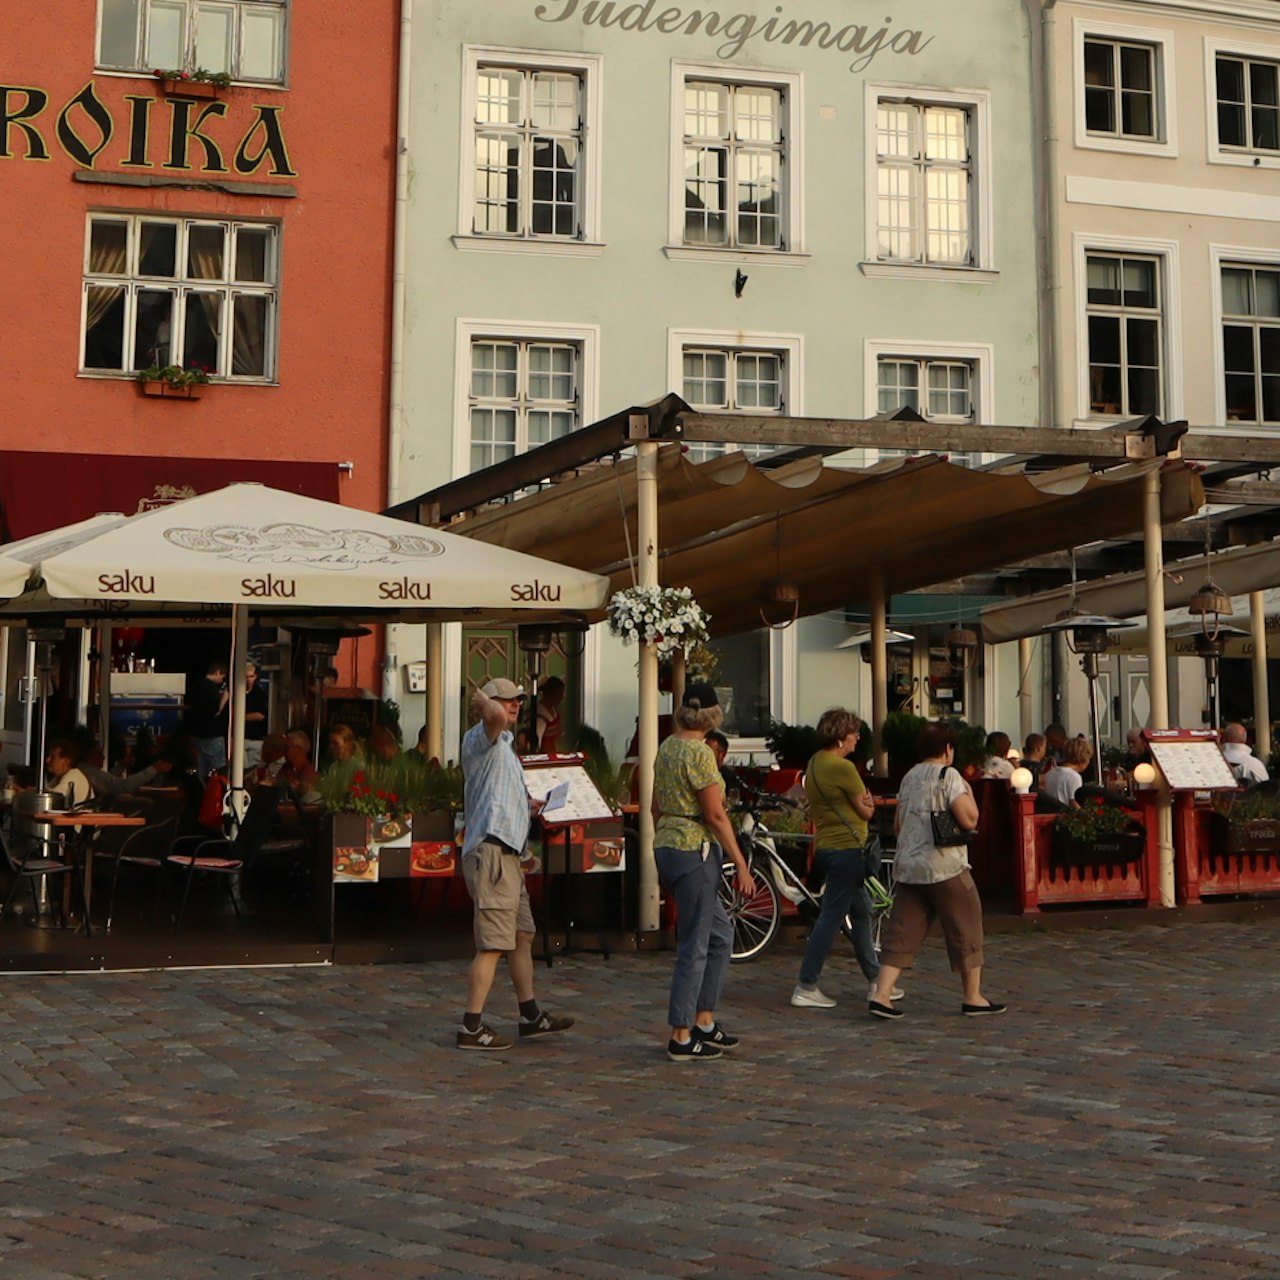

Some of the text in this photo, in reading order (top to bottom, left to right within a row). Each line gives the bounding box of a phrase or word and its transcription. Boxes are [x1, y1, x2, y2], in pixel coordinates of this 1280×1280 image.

[98, 569, 155, 594] saku
[240, 574, 296, 598] saku
[378, 577, 431, 601] saku
[510, 579, 561, 602] saku
